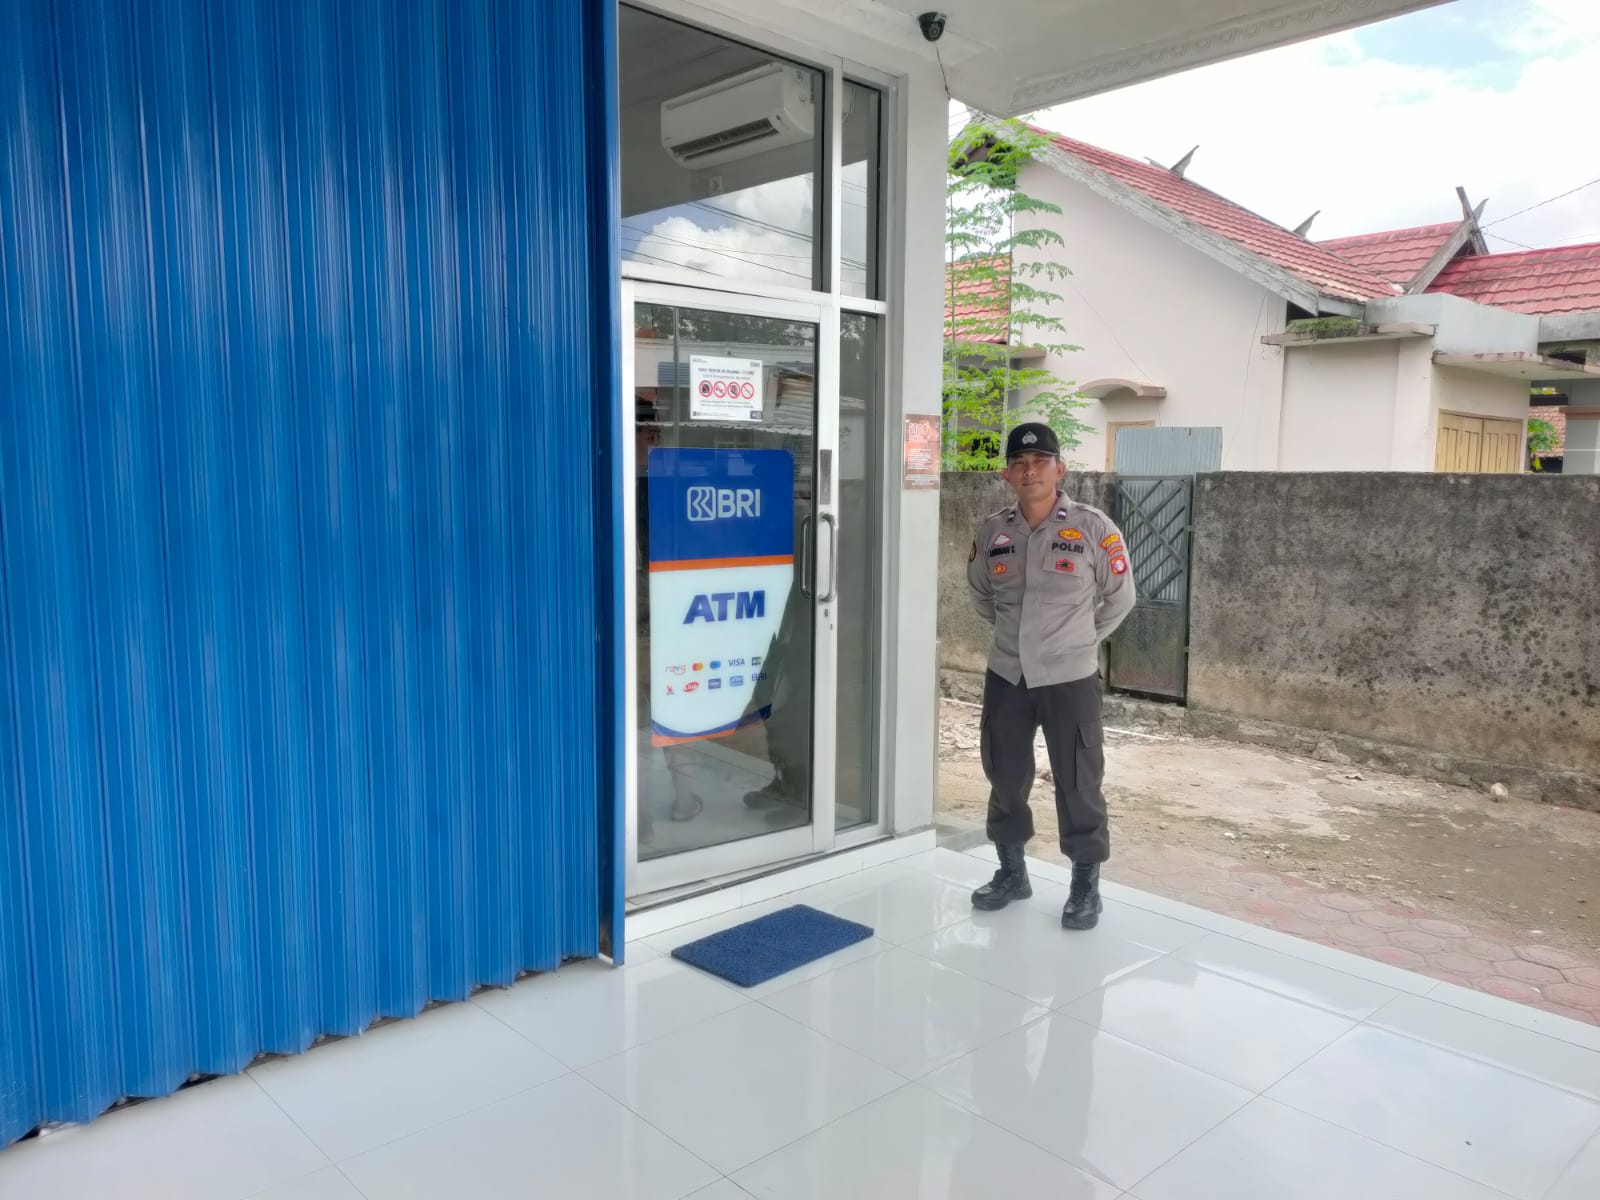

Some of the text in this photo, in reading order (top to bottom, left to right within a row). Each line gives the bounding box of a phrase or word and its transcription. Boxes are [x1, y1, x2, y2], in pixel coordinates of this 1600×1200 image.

[718, 488, 761, 518] BRI
[1052, 542, 1084, 554] POLRI
[683, 590, 766, 624] ATM
[728, 657, 745, 667] VISA
